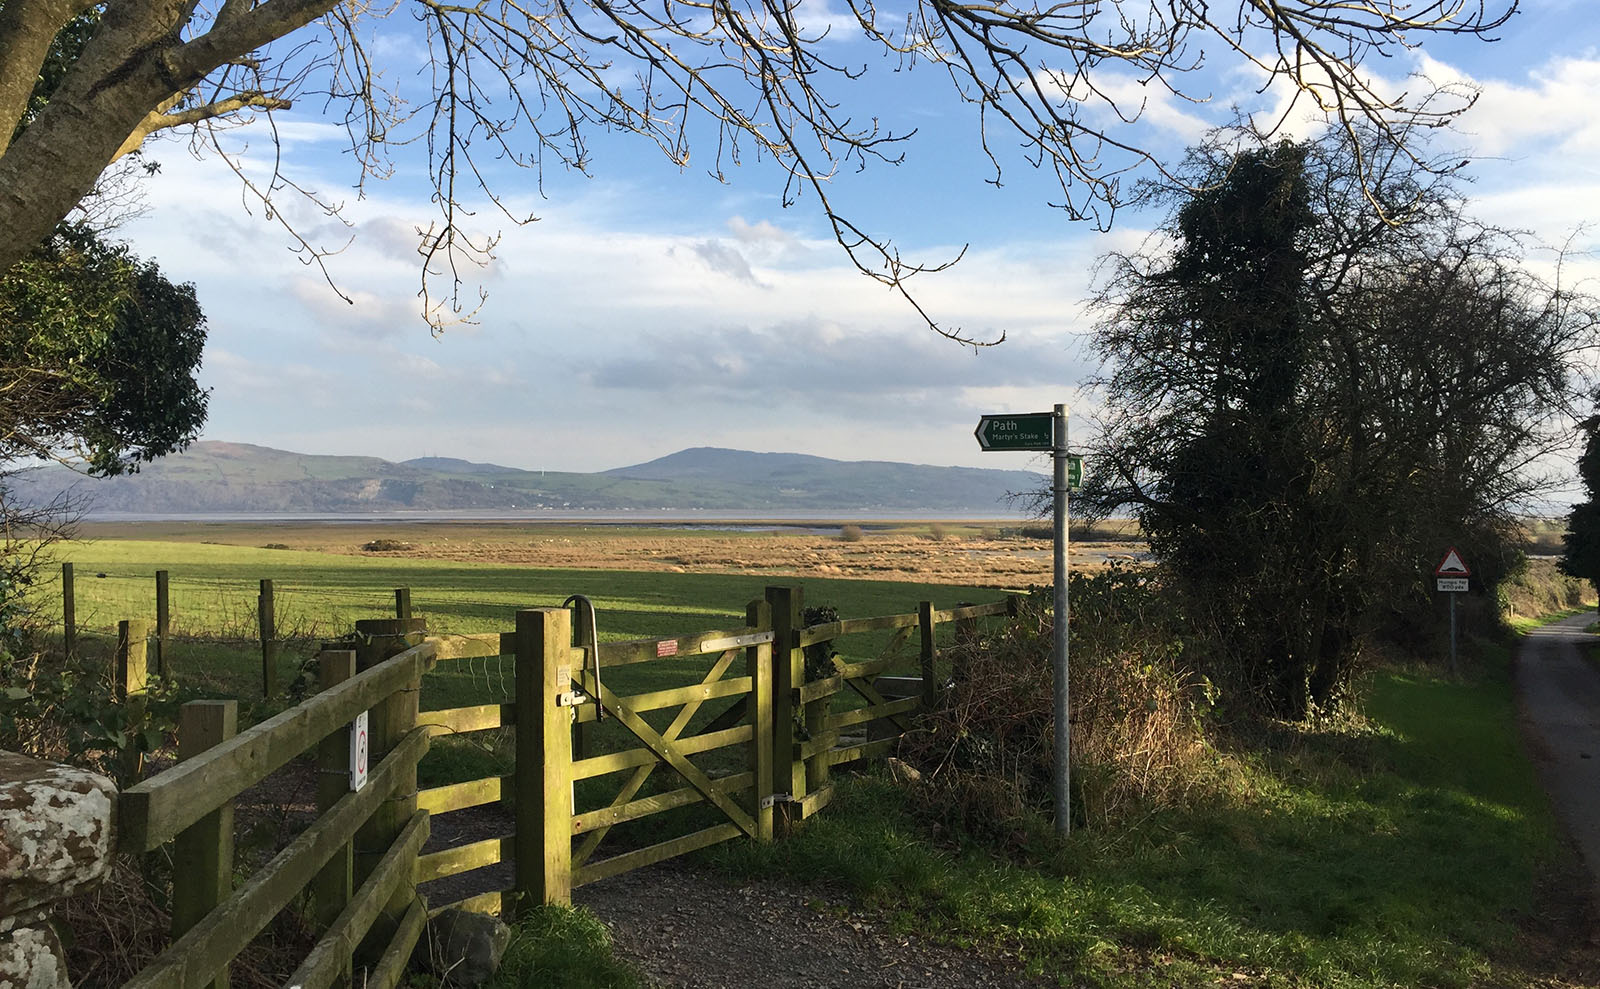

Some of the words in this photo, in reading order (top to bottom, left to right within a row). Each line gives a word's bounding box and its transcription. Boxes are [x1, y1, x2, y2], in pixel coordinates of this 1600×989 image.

[993, 420, 1017, 431] Path
[992, 433, 1018, 441] Martyr's
[1019, 432, 1039, 440] Stake
